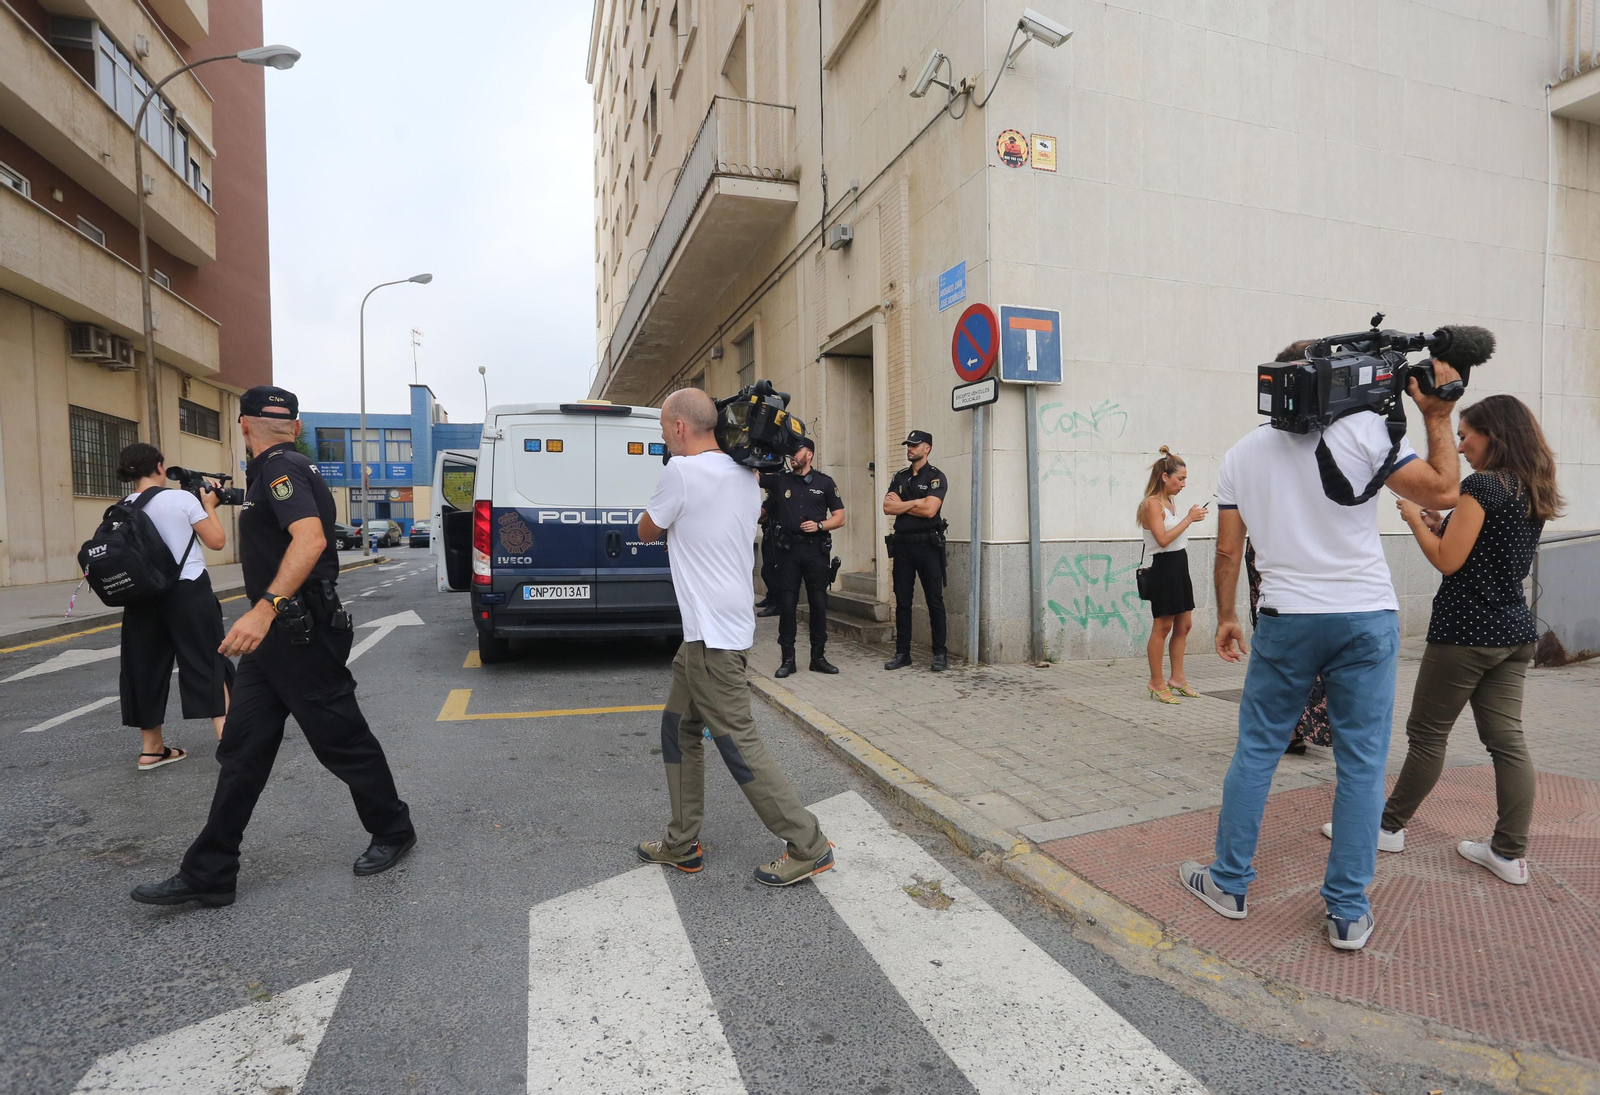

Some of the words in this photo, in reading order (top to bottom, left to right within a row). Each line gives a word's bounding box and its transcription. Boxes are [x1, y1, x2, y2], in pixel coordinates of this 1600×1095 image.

[88, 544, 107, 557] HTV
[498, 556, 532, 565] IVECO
[529, 586, 588, 598] CNP7013AT
